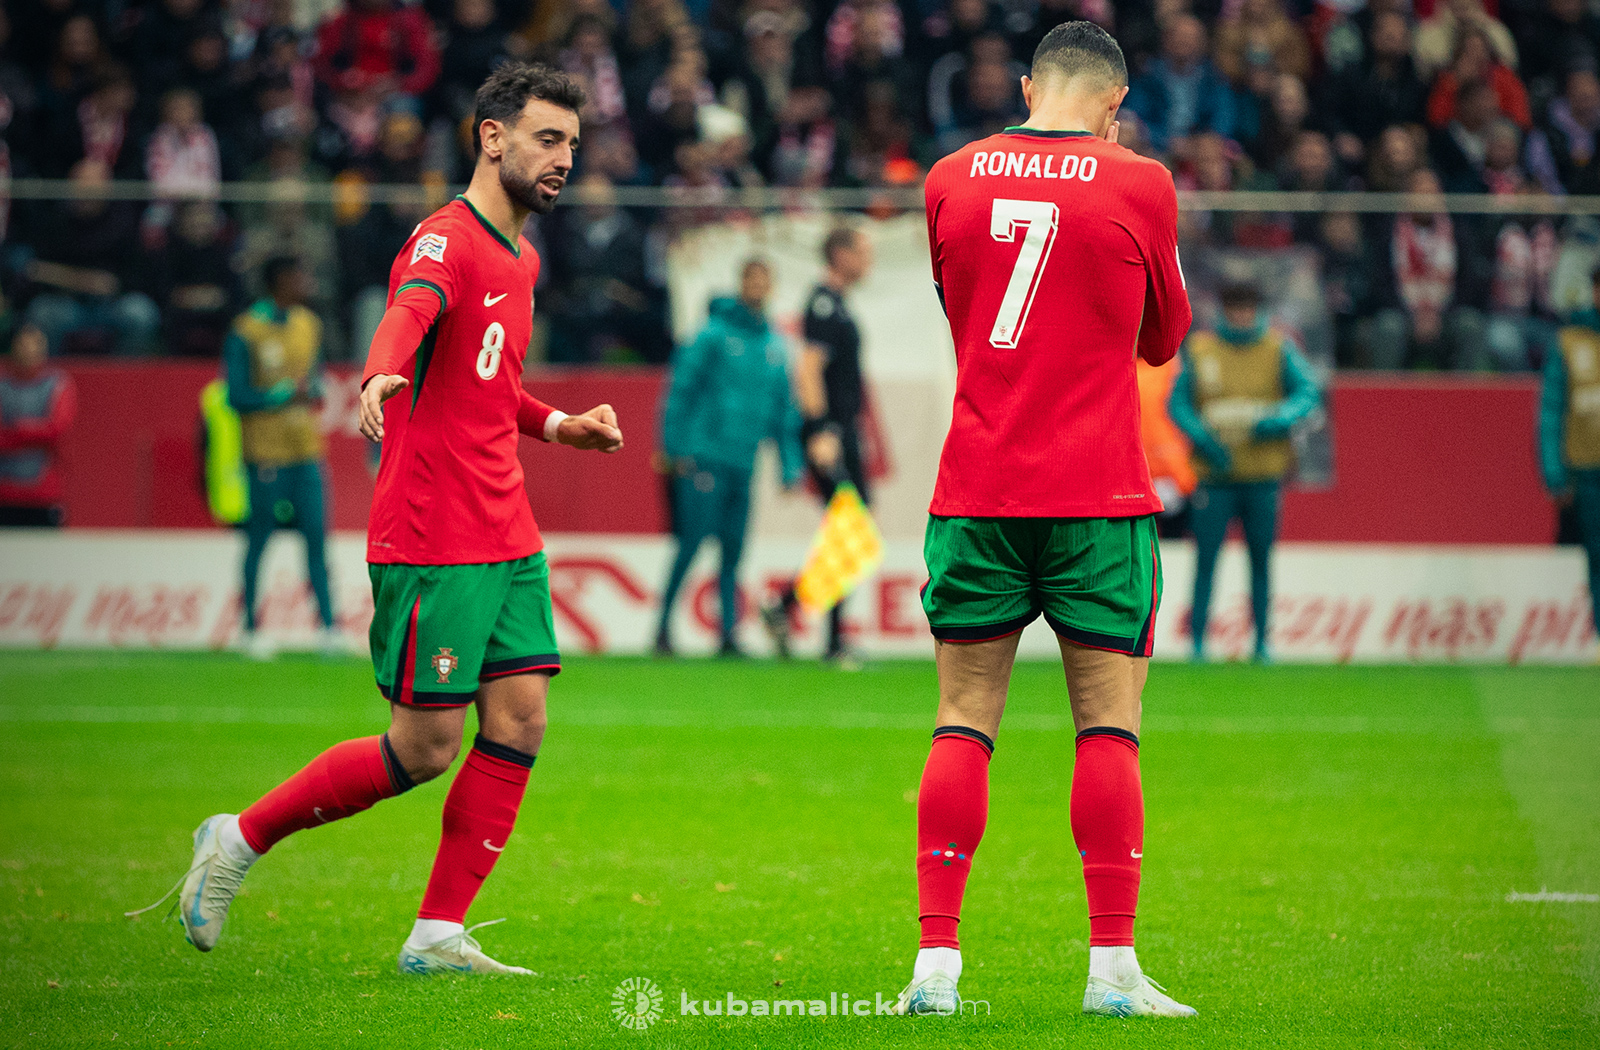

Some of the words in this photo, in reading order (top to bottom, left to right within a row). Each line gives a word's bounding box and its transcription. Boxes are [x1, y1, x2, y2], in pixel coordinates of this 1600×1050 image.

[970, 151, 1098, 182] RONALDO
[989, 198, 1060, 349] 7
[476, 321, 506, 381] 8
